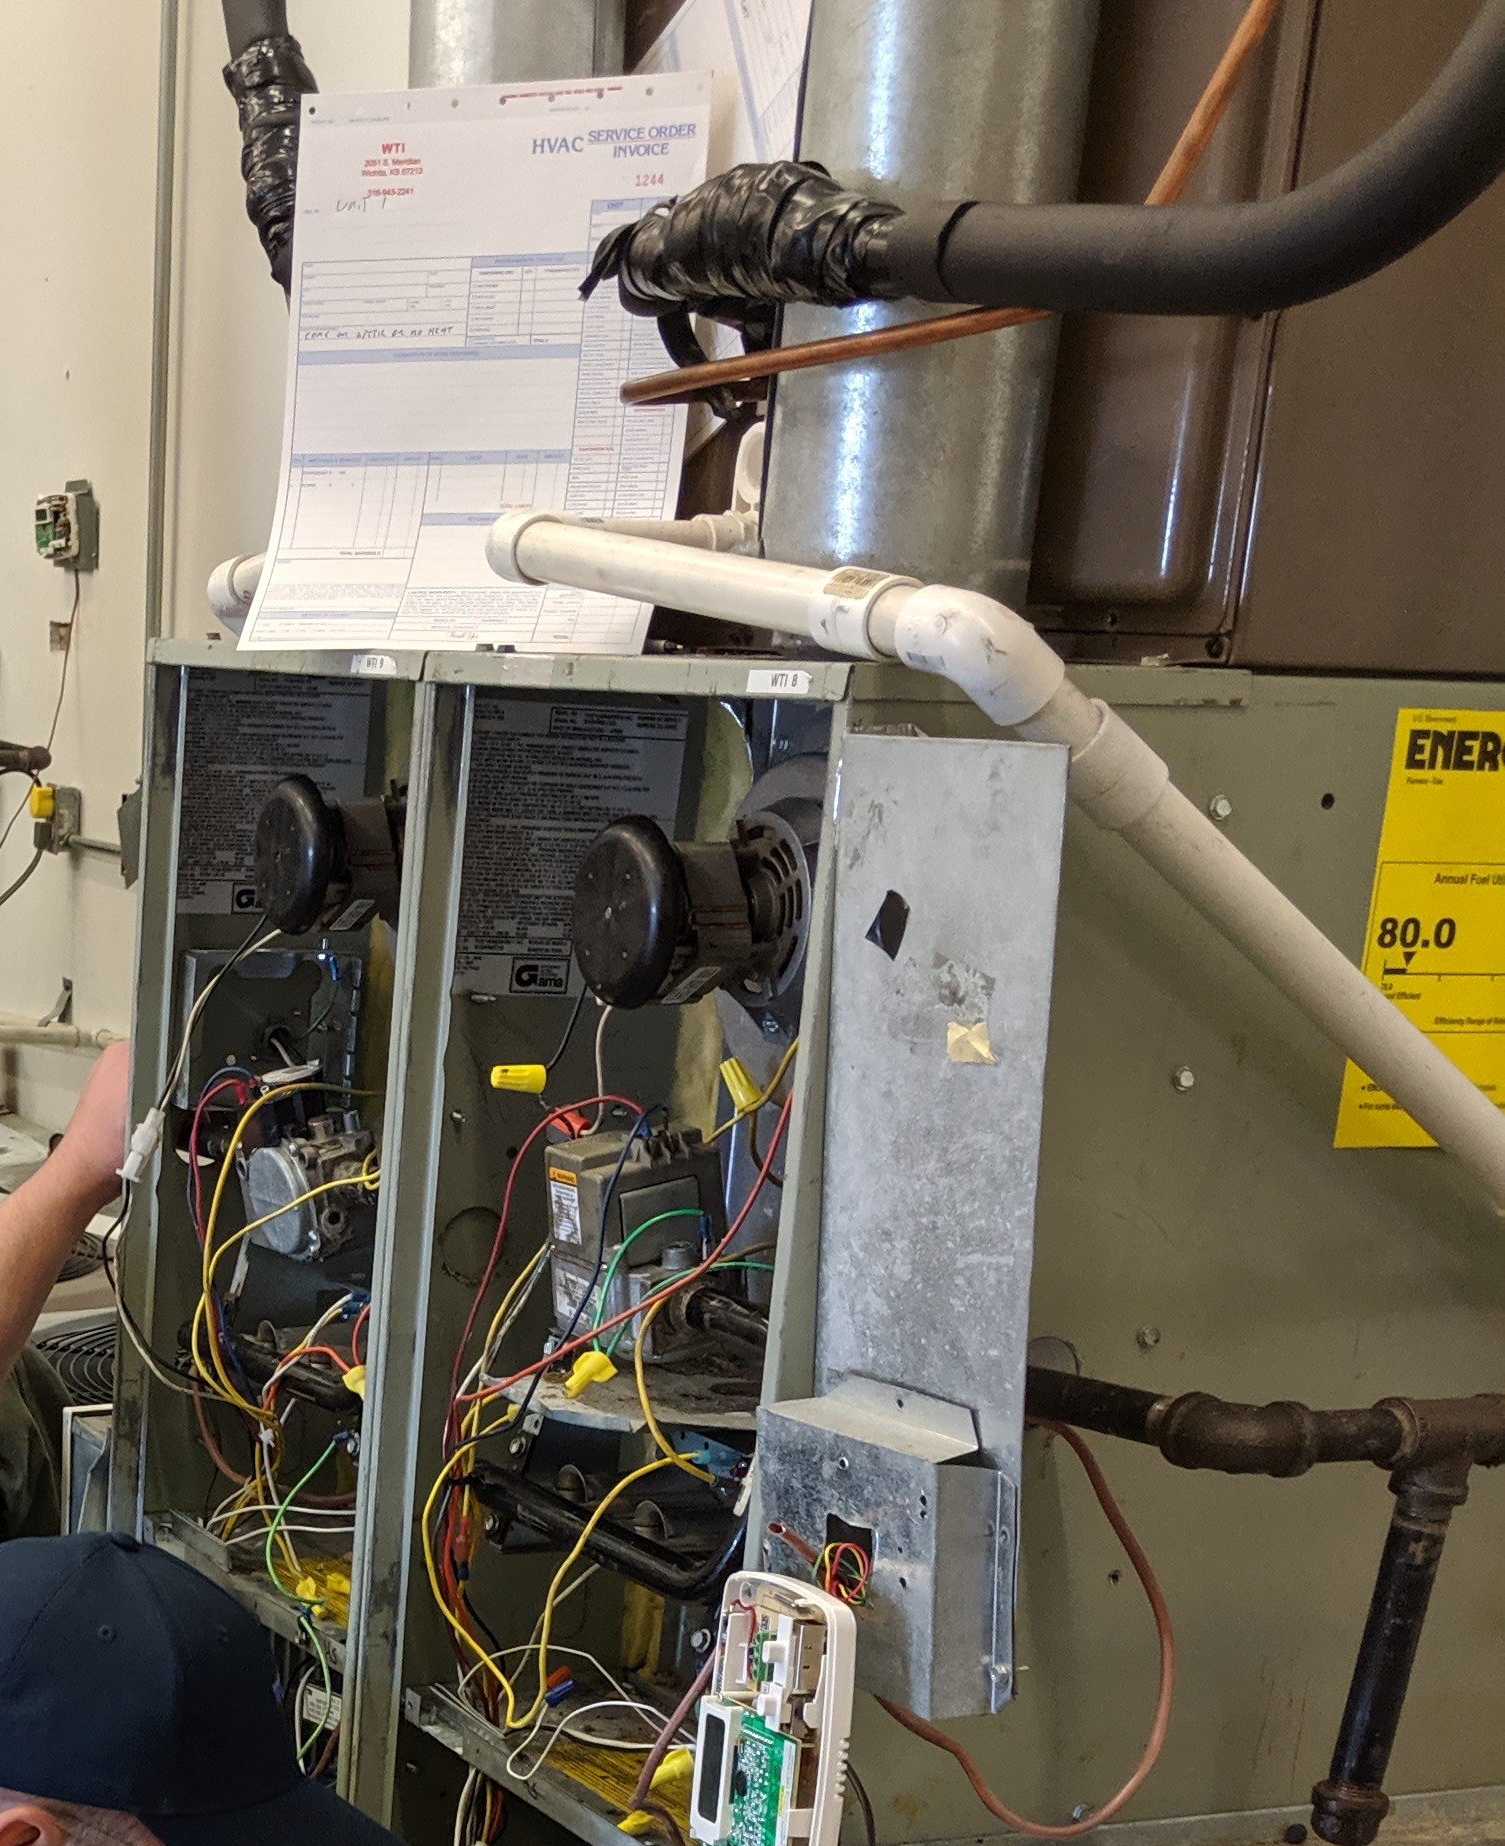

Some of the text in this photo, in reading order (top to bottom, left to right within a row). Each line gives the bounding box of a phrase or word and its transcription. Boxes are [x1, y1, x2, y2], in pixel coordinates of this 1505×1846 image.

[532, 123, 696, 155] HVAC SERVICE ORDER
[382, 143, 405, 154] WTI
[613, 142, 670, 158] INVOICE
[635, 173, 664, 187] 1244
[770, 674, 798, 688] WTI 8
[1405, 728, 1505, 772] ENER
[1434, 872, 1469, 885] Annual
[1470, 873, 1490, 885] Fuel
[1377, 917, 1456, 949] 80.0
